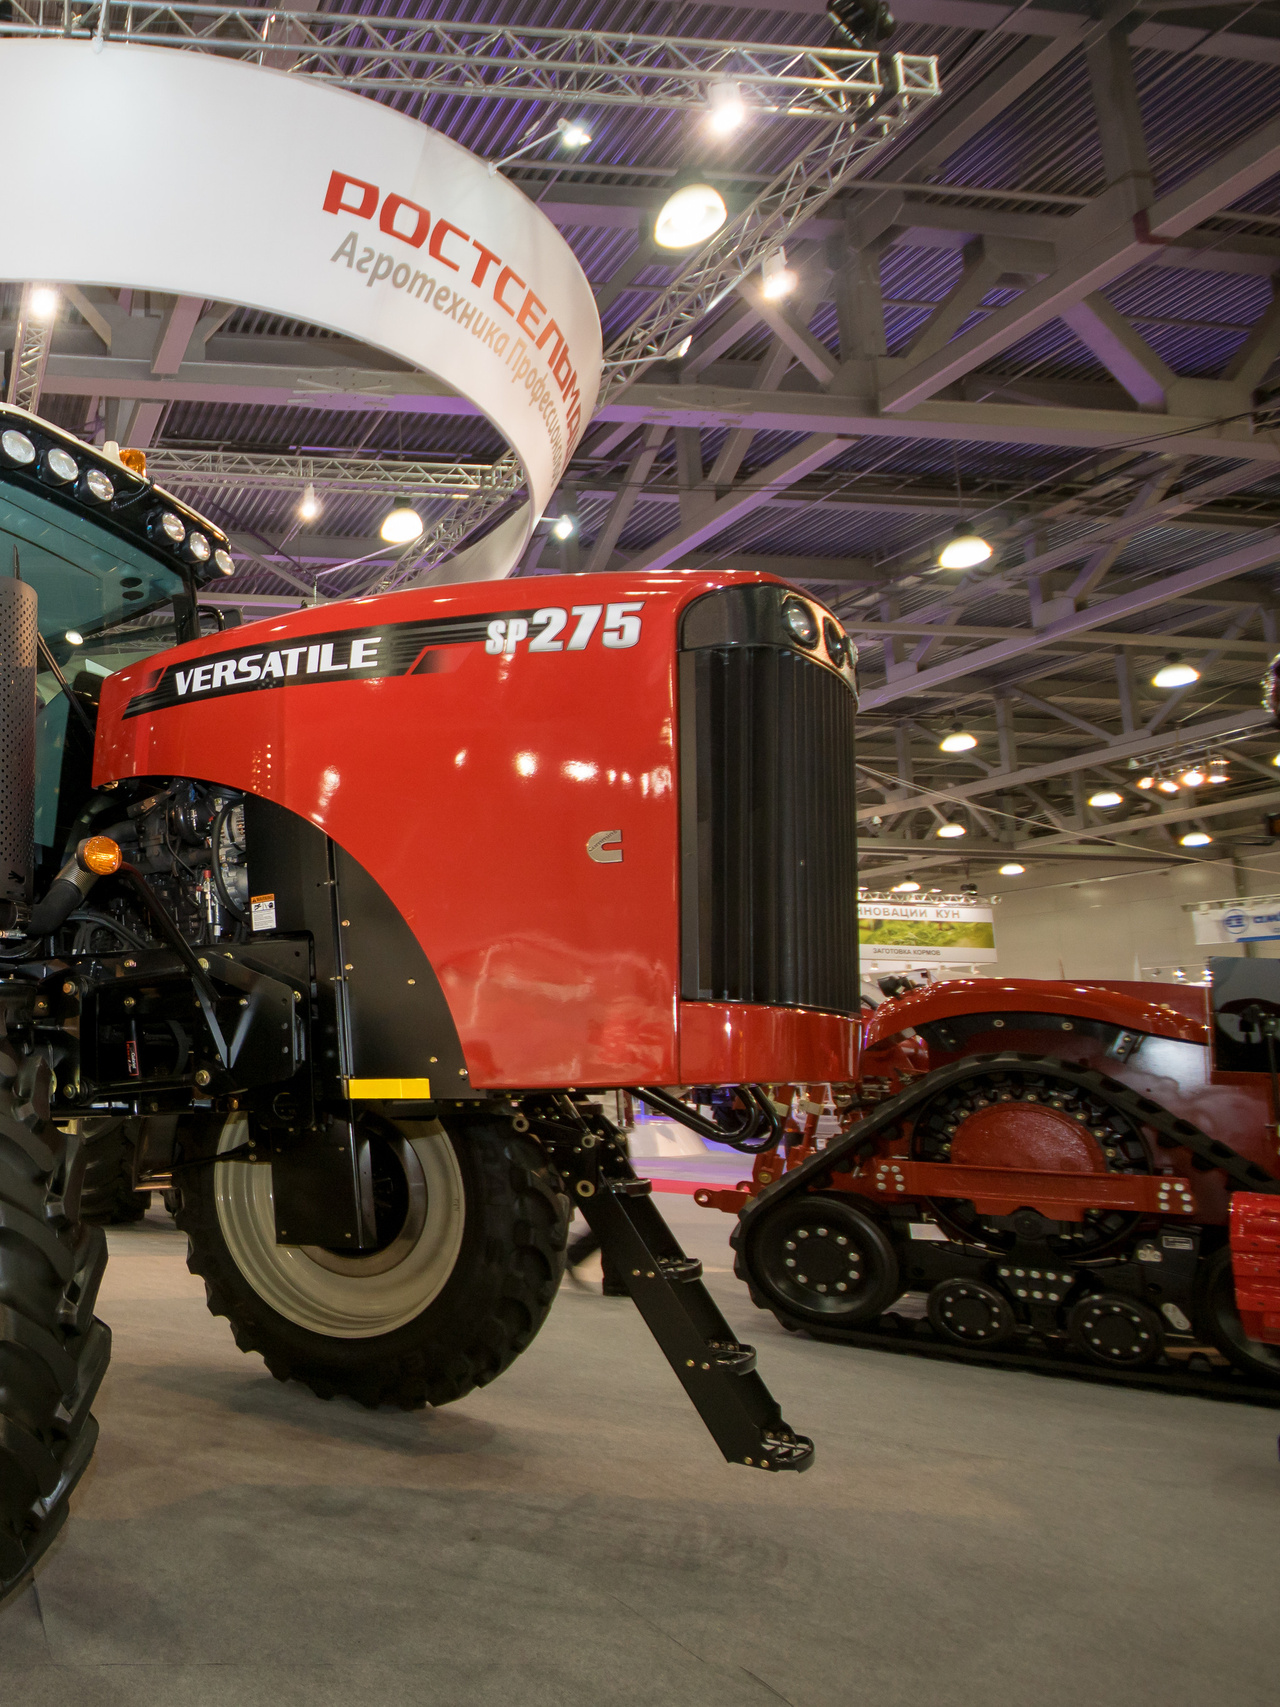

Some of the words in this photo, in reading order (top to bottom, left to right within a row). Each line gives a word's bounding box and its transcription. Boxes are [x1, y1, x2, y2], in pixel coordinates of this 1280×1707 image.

[329, 230, 511, 358] Агротехника
[175, 636, 382, 696] VERSATILE
[935, 909, 961, 919] КУН
[872, 947, 912, 956] ЗАГОТОВКА
[913, 948, 941, 957] КОРМОВ
